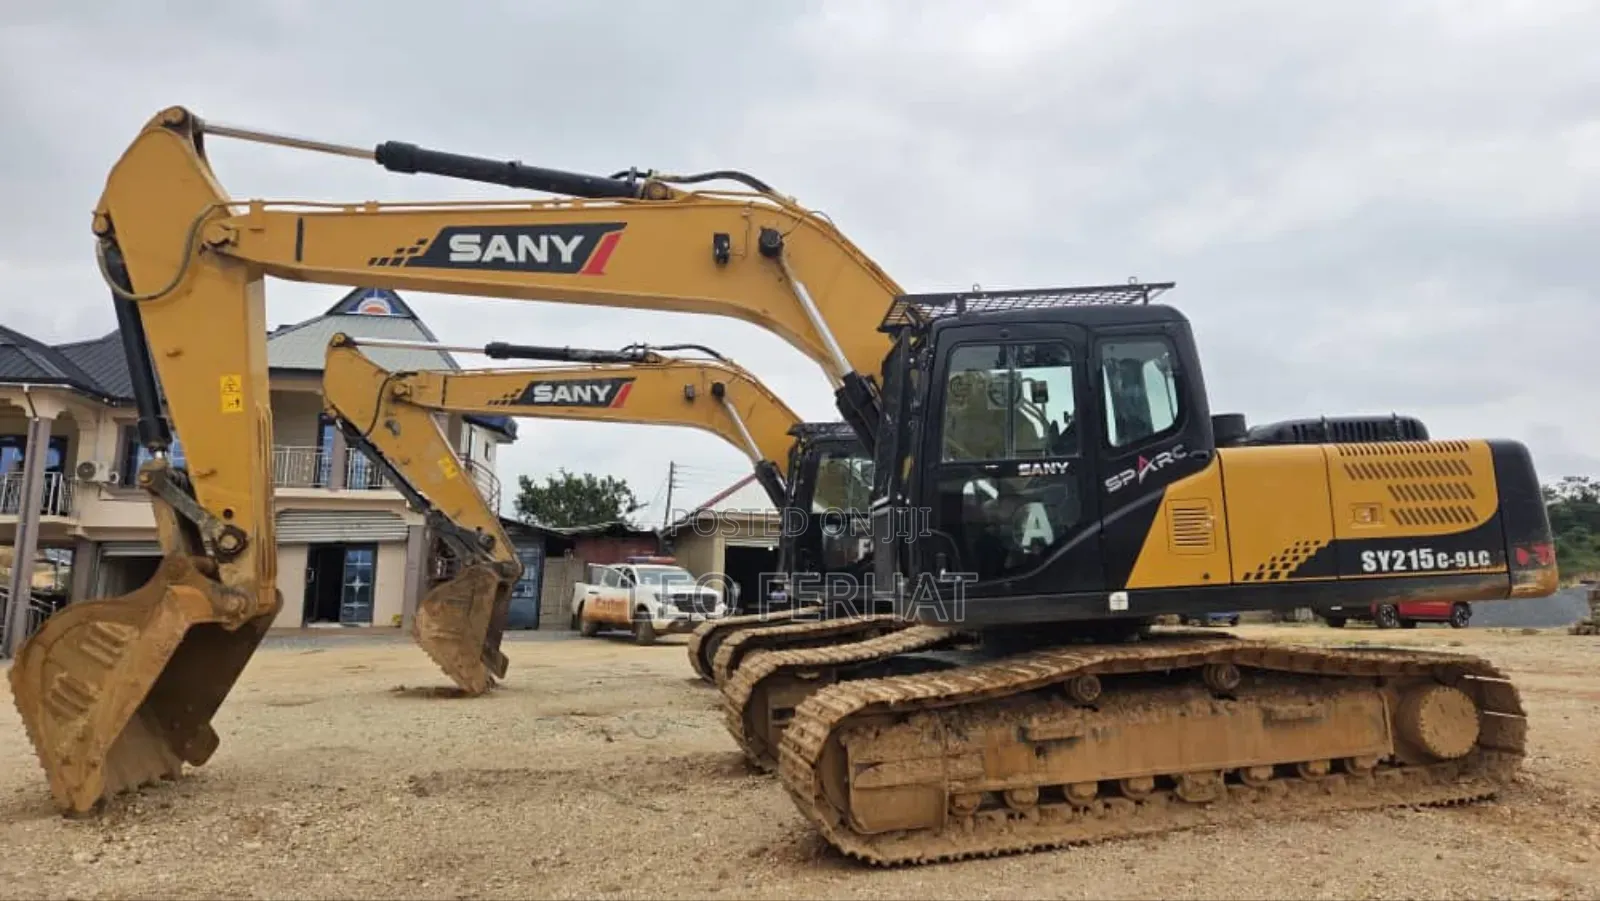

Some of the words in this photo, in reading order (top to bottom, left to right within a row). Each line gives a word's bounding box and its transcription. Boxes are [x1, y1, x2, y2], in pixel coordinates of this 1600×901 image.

[449, 234, 584, 264] SANY
[533, 384, 612, 403] SANY
[1018, 461, 1070, 476] SANY
[1104, 444, 1187, 493] SPARC
